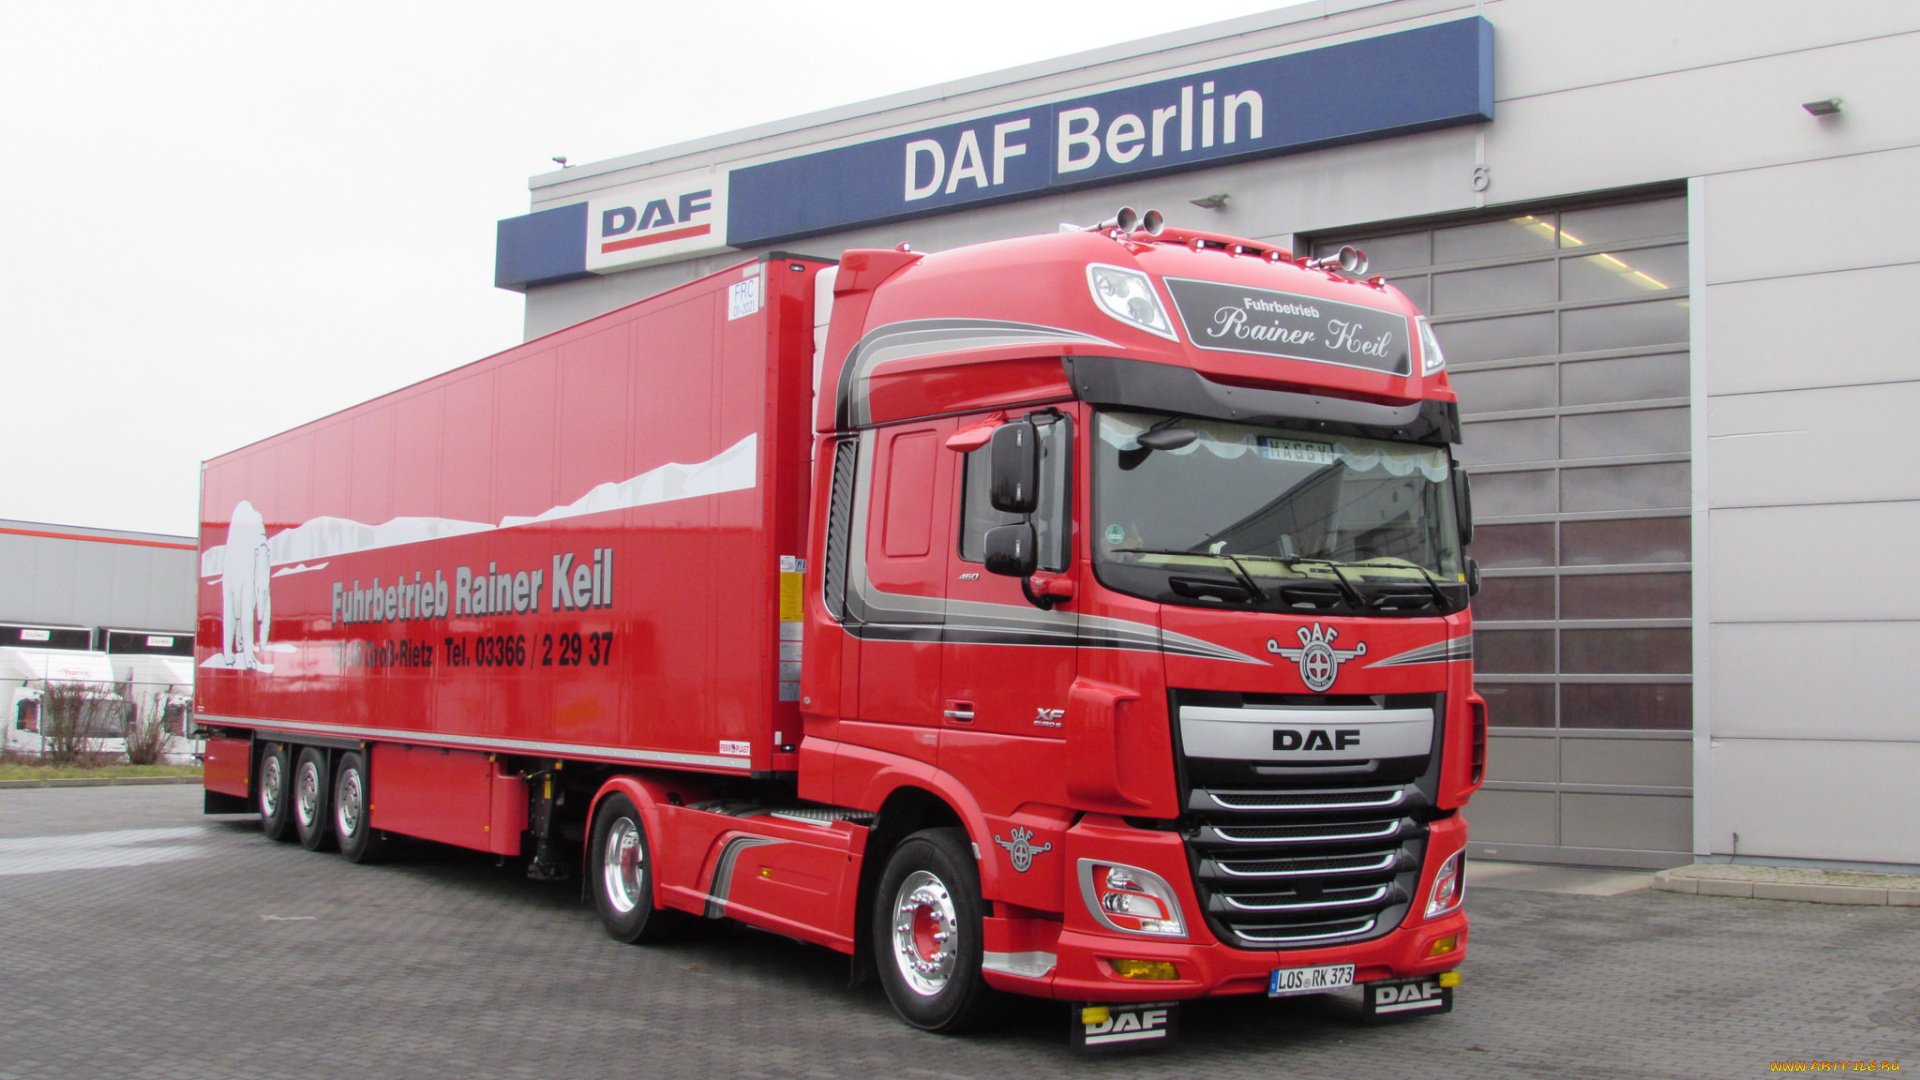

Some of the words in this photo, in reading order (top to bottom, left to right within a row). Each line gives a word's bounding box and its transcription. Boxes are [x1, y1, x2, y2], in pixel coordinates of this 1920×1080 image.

[905, 118, 1030, 201] DAF
[1058, 81, 1263, 174] Berlin
[1472, 164, 1490, 192] 6
[602, 189, 712, 238] DAF
[734, 279, 754, 303] FRC
[1243, 298, 1319, 318] Fuhrbetrieb
[1206, 306, 1315, 345] Rainer
[1325, 319, 1392, 357] Keil
[332, 569, 449, 626] Fuhrbetrieb
[455, 561, 543, 618] Rainer
[552, 547, 613, 613] Keil
[1296, 621, 1339, 646] DAF
[366, 639, 433, 668] Groß-Rietz
[445, 637, 471, 667] Tel.
[476, 635, 526, 667] 03366
[530, 633, 537, 671] /
[542, 634, 553, 667] 2
[559, 633, 582, 667] 29
[589, 632, 613, 667] 37
[1035, 708, 1065, 721] XF
[1273, 730, 1360, 750] DAF
[1011, 825, 1034, 840] DAF
[1279, 971, 1303, 989] LOS
[1312, 969, 1327, 987] RK
[1330, 966, 1353, 985] 373
[1376, 982, 1442, 1005] DAF
[1086, 1010, 1167, 1035] DAF
